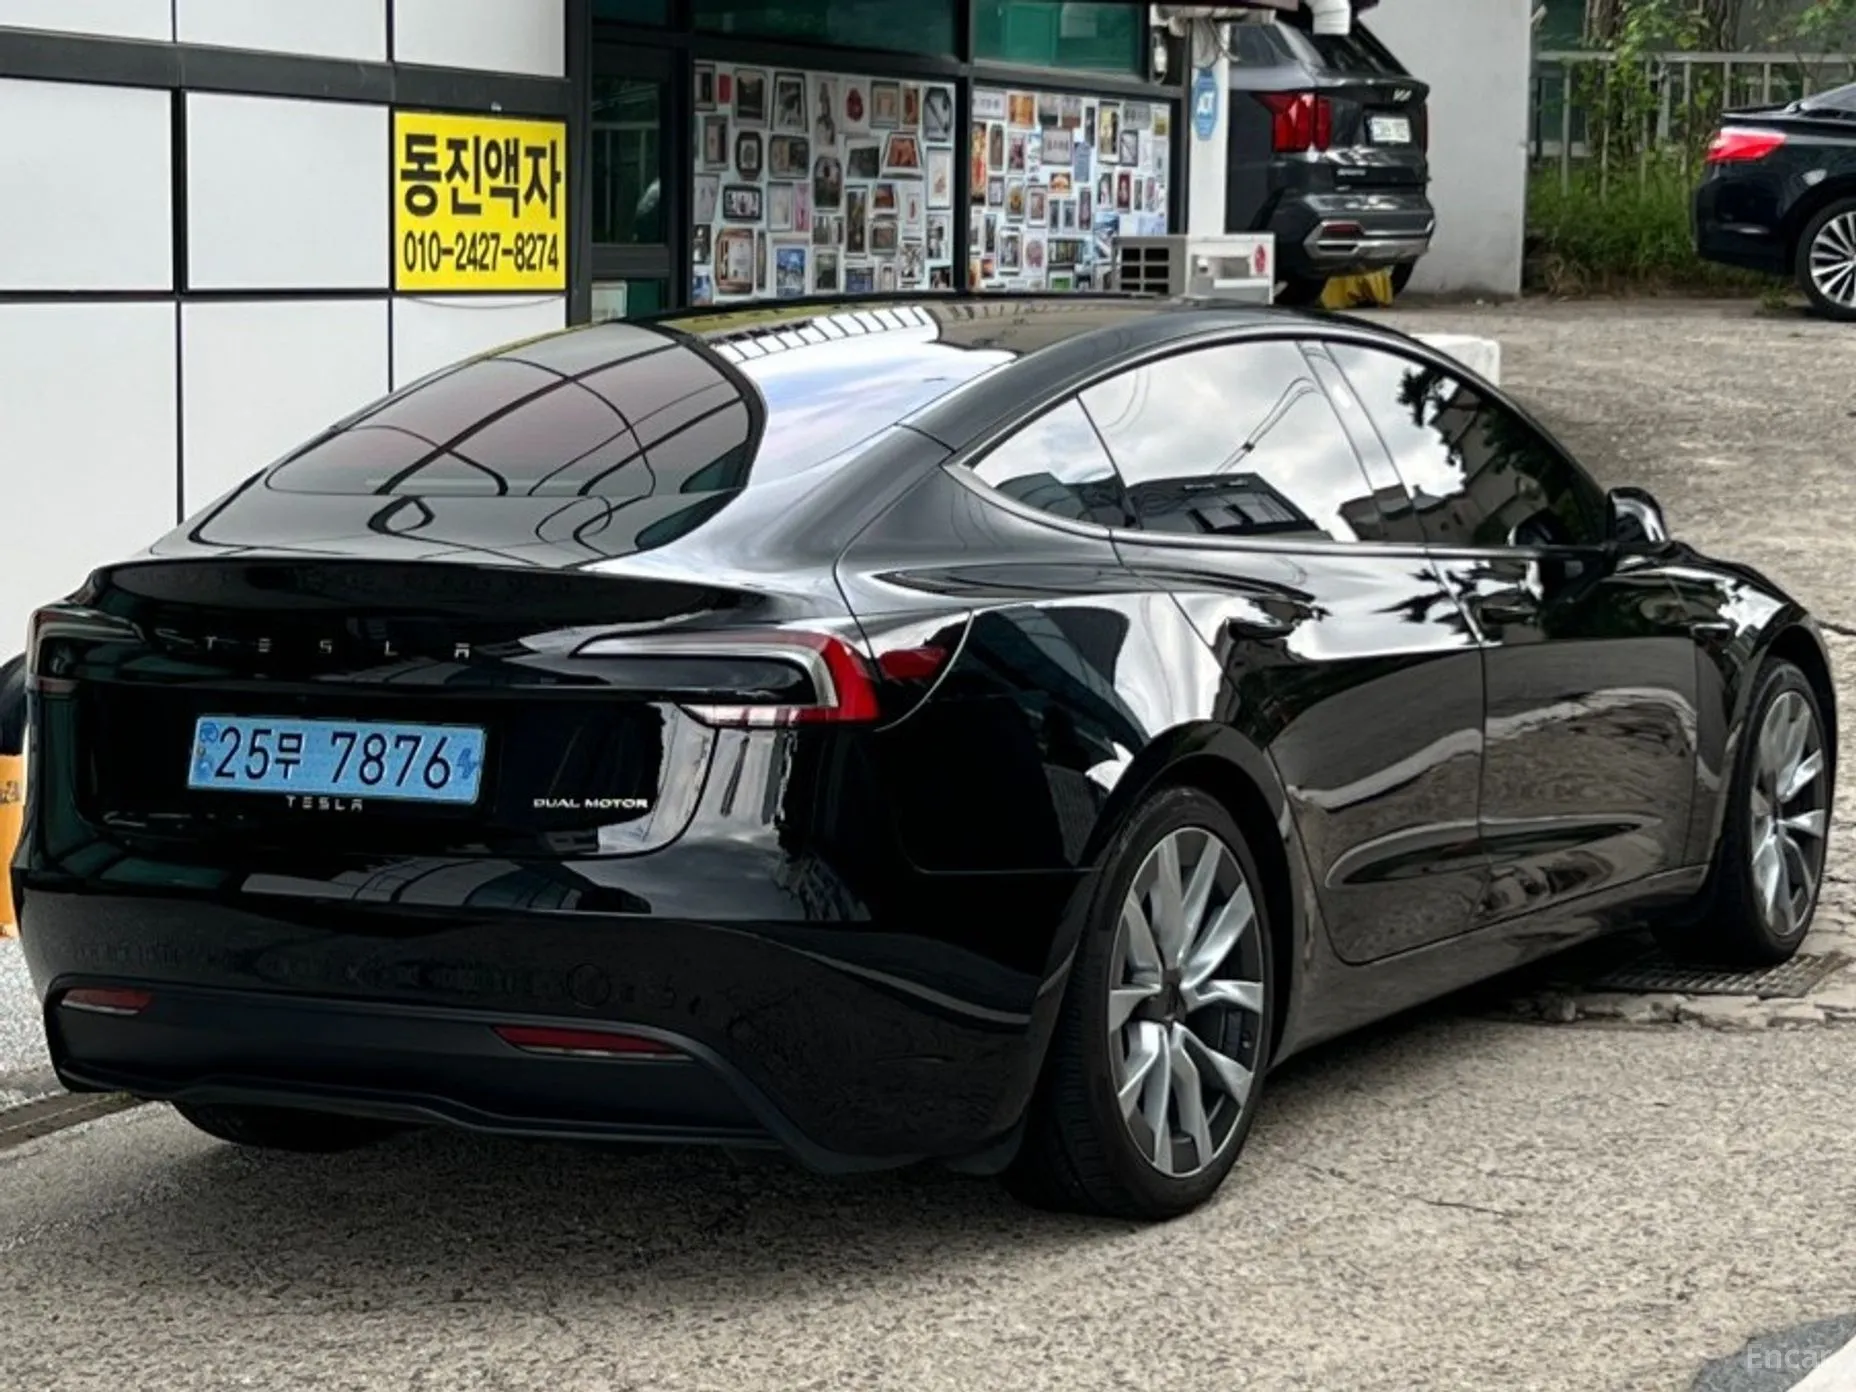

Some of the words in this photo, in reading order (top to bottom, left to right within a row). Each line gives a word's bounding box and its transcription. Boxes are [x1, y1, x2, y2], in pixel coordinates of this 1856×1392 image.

[400, 133, 561, 219] 동진액자
[404, 230, 559, 273] 010-2427-8274
[214, 726, 303, 780] 25무
[330, 731, 451, 789] 7876
[286, 795, 363, 811] TESLA
[533, 798, 580, 809] DUAL
[585, 798, 648, 809] MOTOR
